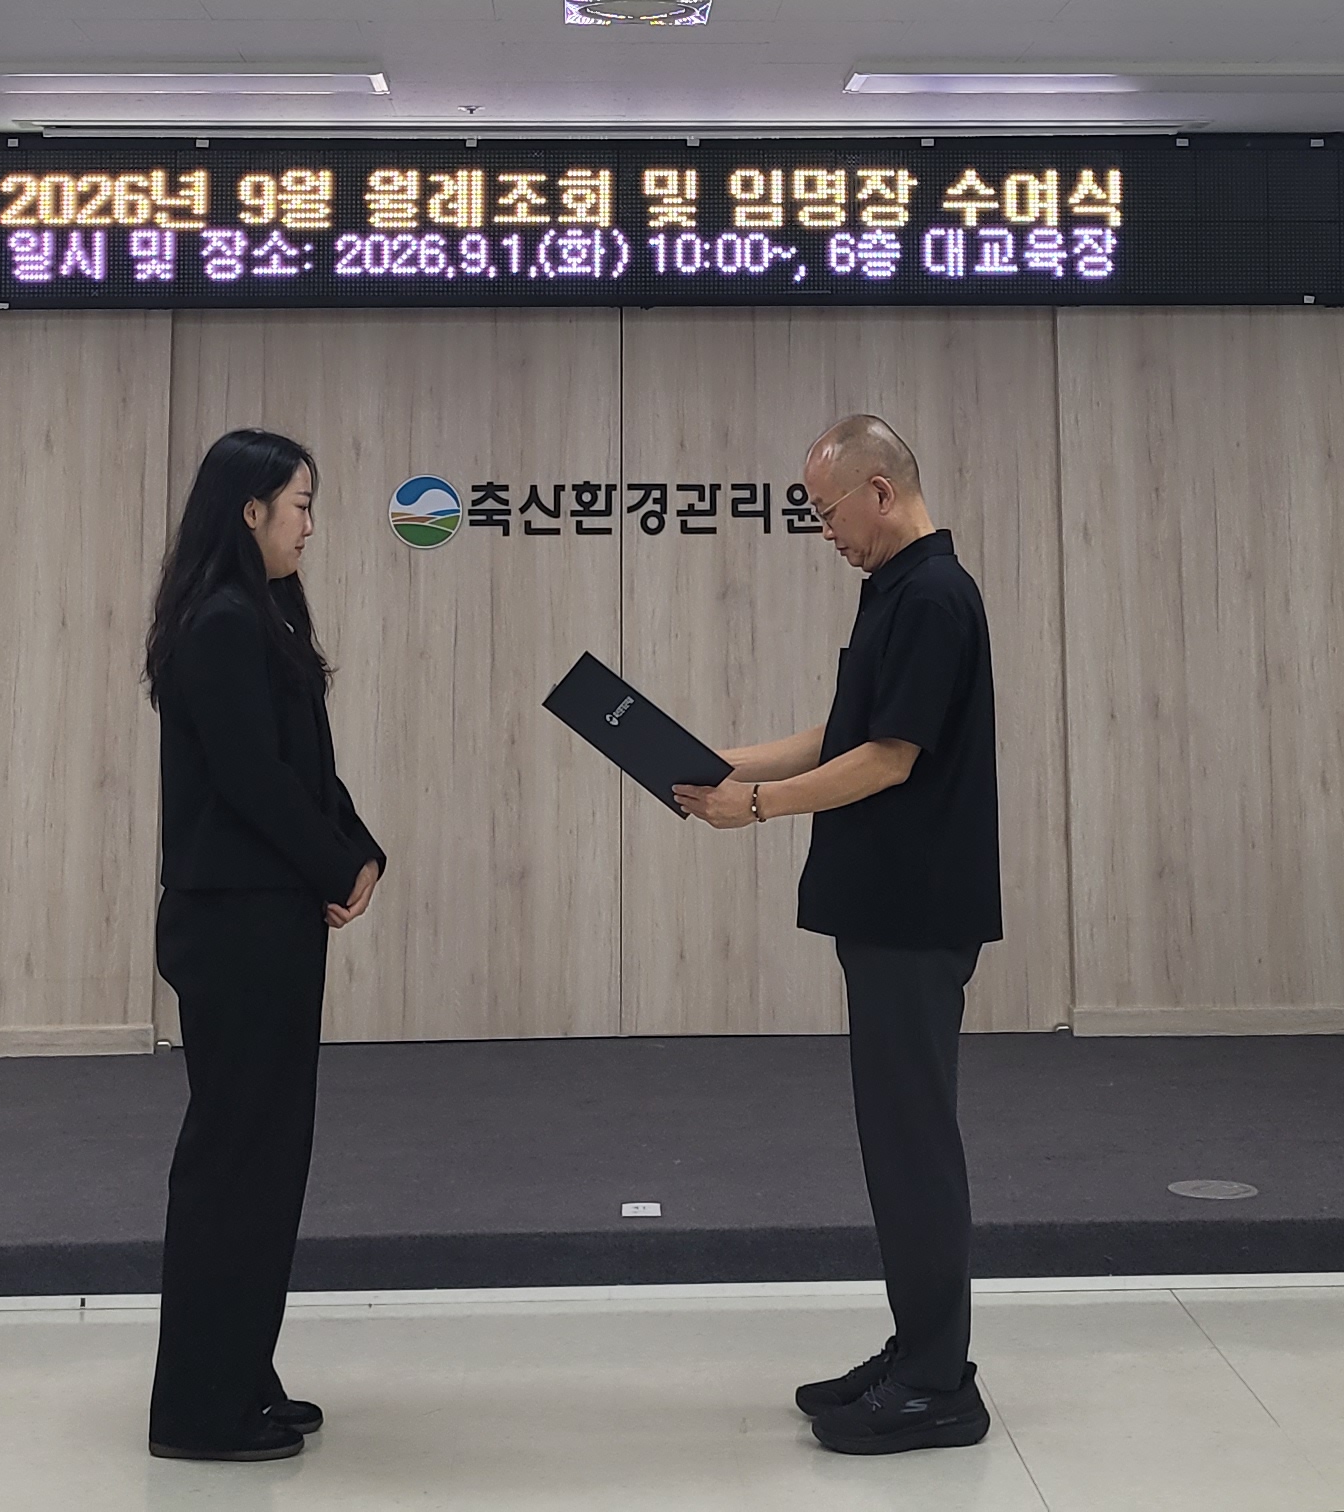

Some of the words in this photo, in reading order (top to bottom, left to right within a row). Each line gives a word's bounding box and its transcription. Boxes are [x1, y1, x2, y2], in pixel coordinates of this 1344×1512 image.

[237, 169, 334, 229] 9월
[364, 169, 612, 228] 월례조회
[642, 169, 698, 228] 및
[729, 169, 918, 228] 임명장
[943, 168, 1123, 228] 수여식
[7, 229, 107, 281] 일시
[129, 229, 175, 281] 및
[200, 229, 313, 281] 장소:
[829, 230, 901, 279] 6층
[923, 228, 1118, 279] 대교육장
